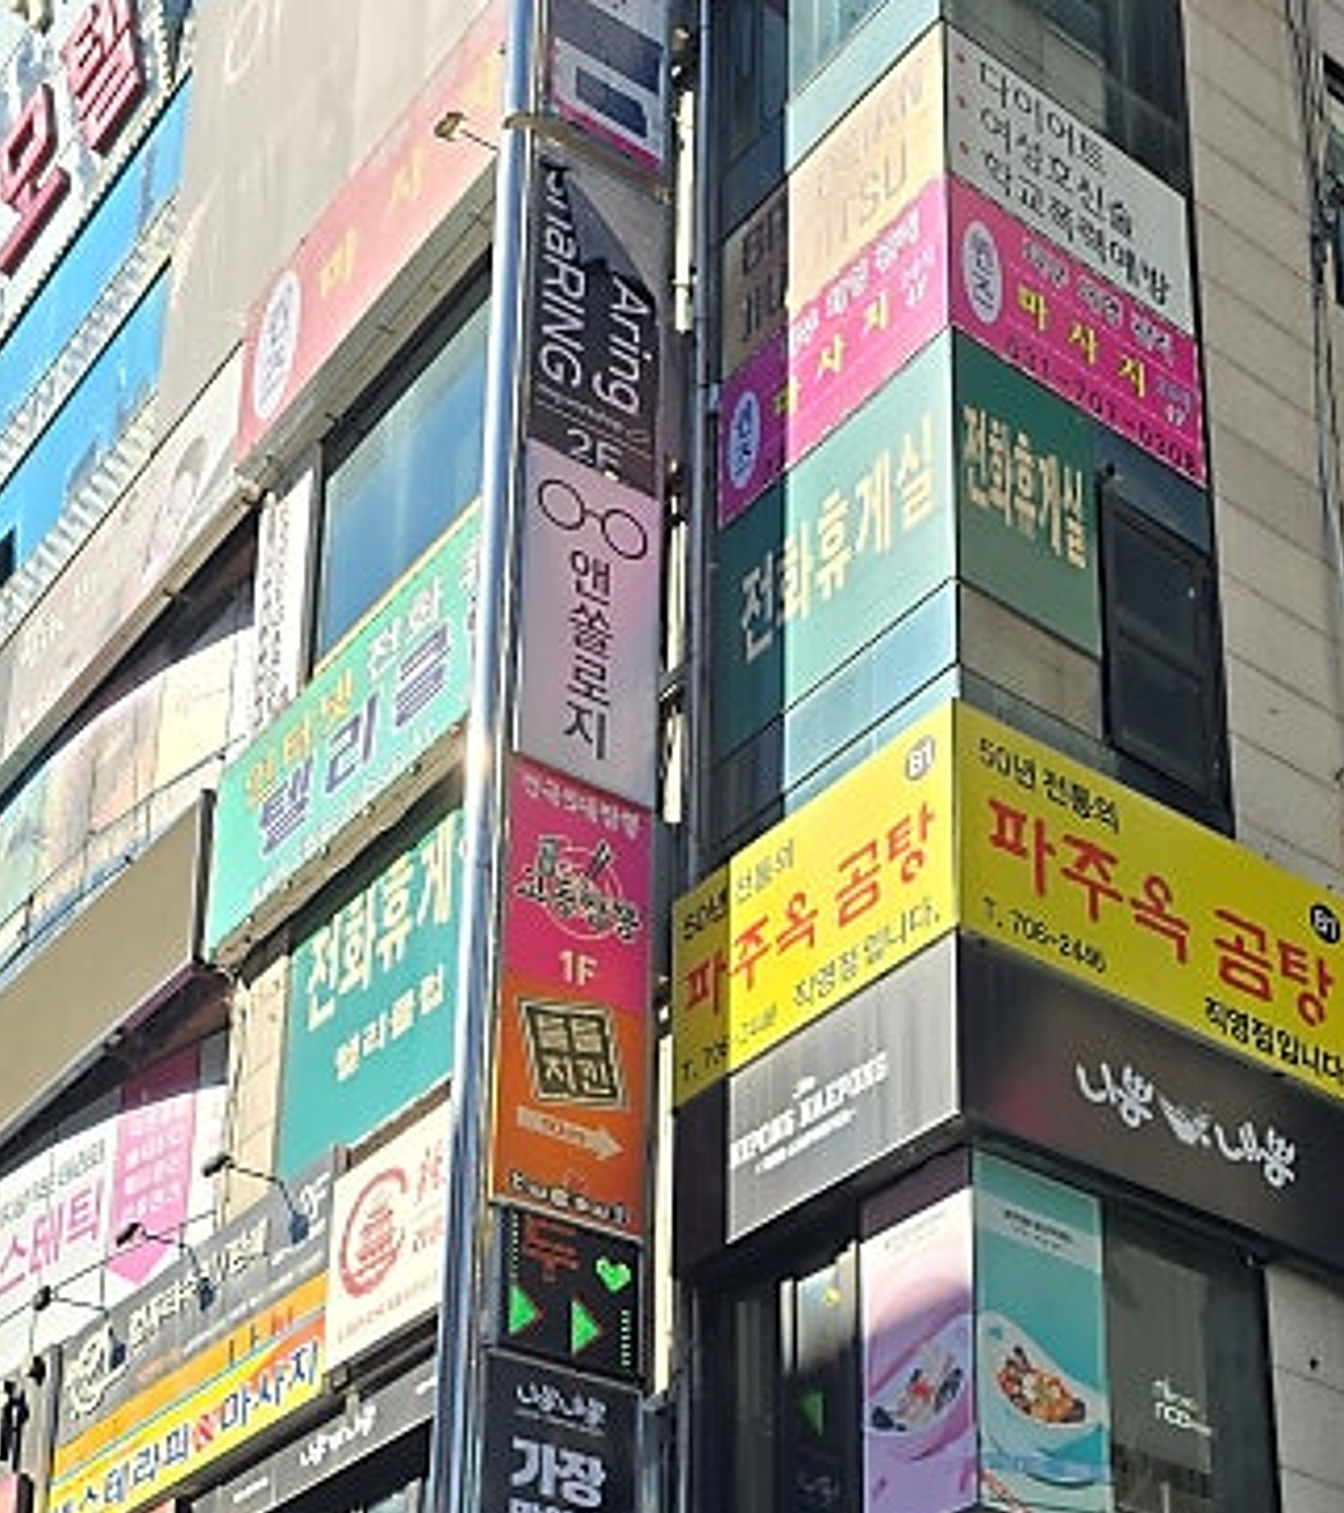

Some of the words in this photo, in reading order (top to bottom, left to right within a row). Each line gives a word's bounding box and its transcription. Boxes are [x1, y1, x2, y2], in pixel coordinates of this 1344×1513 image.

[1018, 284, 1149, 400] 마사지
[737, 412, 936, 664] 전화휴게실
[959, 405, 1088, 572] 전화휴게실
[977, 737, 1036, 792] 50년
[1041, 768, 1120, 836] 전통의
[306, 818, 456, 1034] 전화휴게
[558, 948, 599, 988] 1F
[683, 888, 821, 1018] 파주옥
[834, 800, 937, 930] 곰탕
[987, 796, 1192, 967] 파주옥
[1213, 906, 1336, 1030] 곰탕
[510, 1435, 606, 1510] 가장
